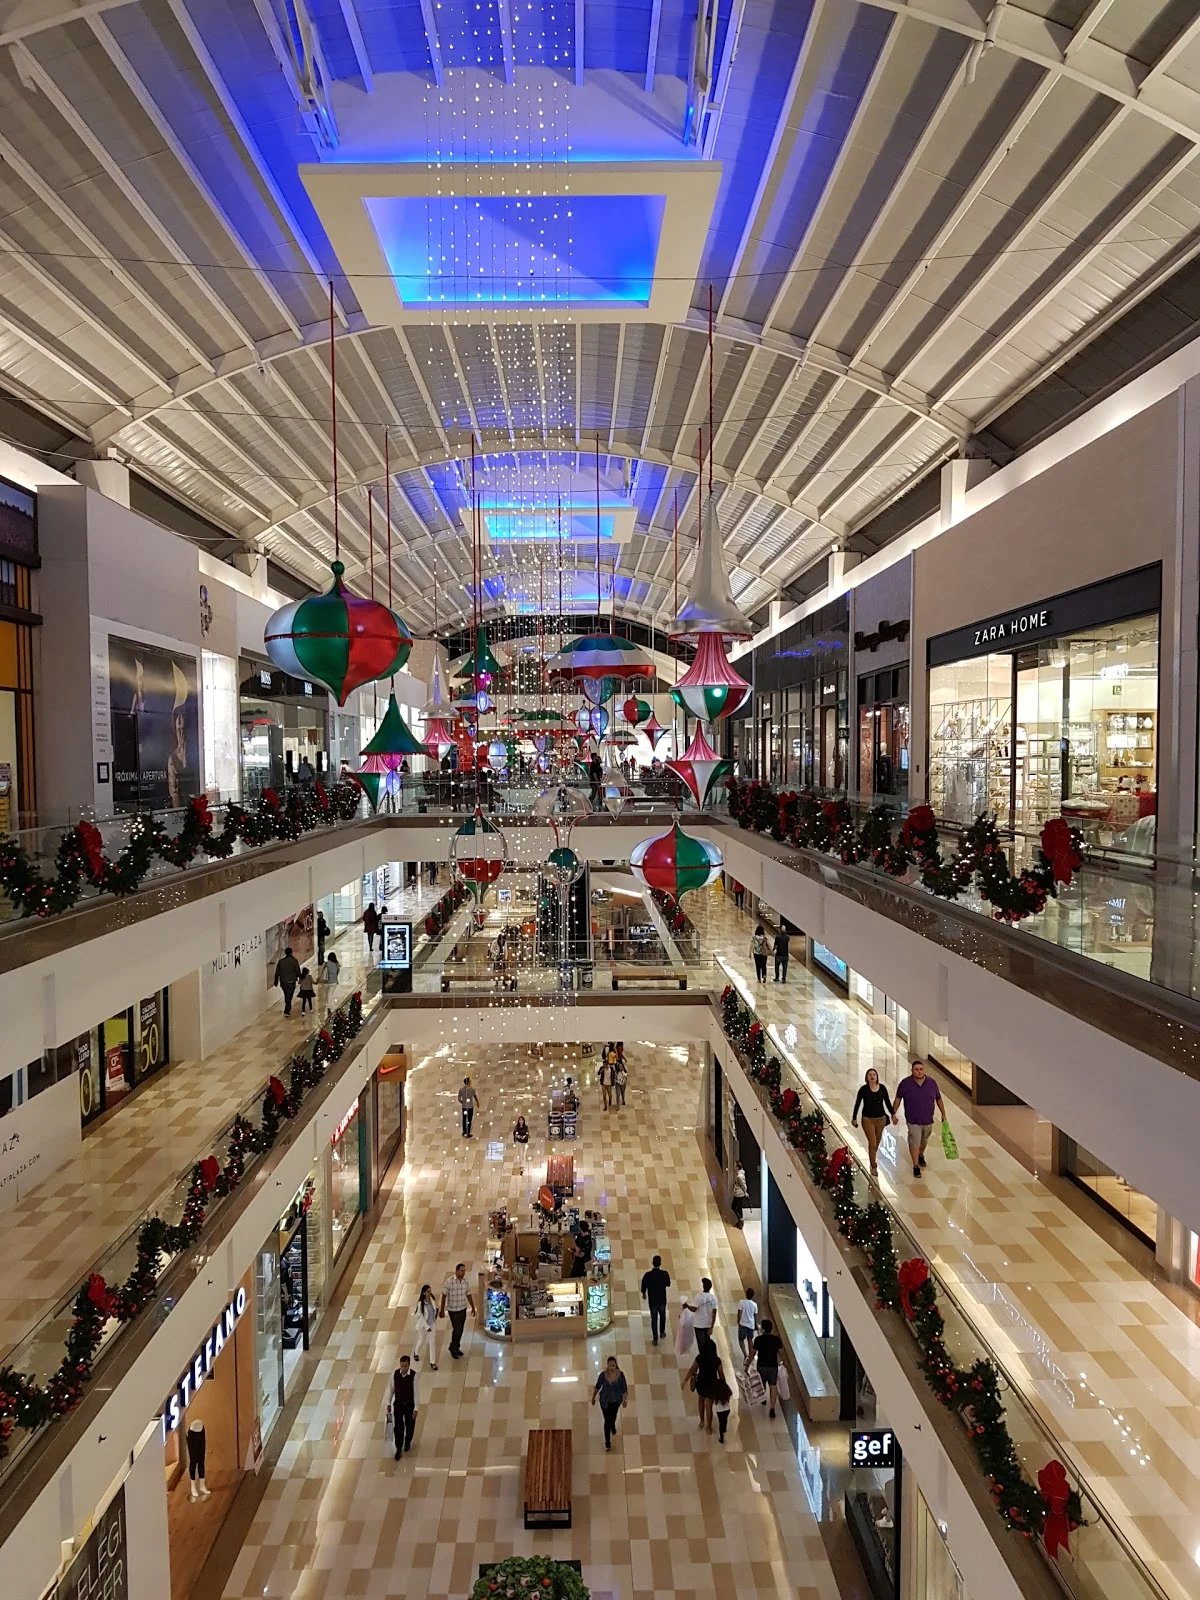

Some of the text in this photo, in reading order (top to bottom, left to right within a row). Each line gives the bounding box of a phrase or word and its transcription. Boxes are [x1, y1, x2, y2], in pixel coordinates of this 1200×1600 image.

[974, 610, 1048, 646] ZARA HOME
[260, 669, 272, 685] BOSS
[853, 1433, 892, 1460] gef
